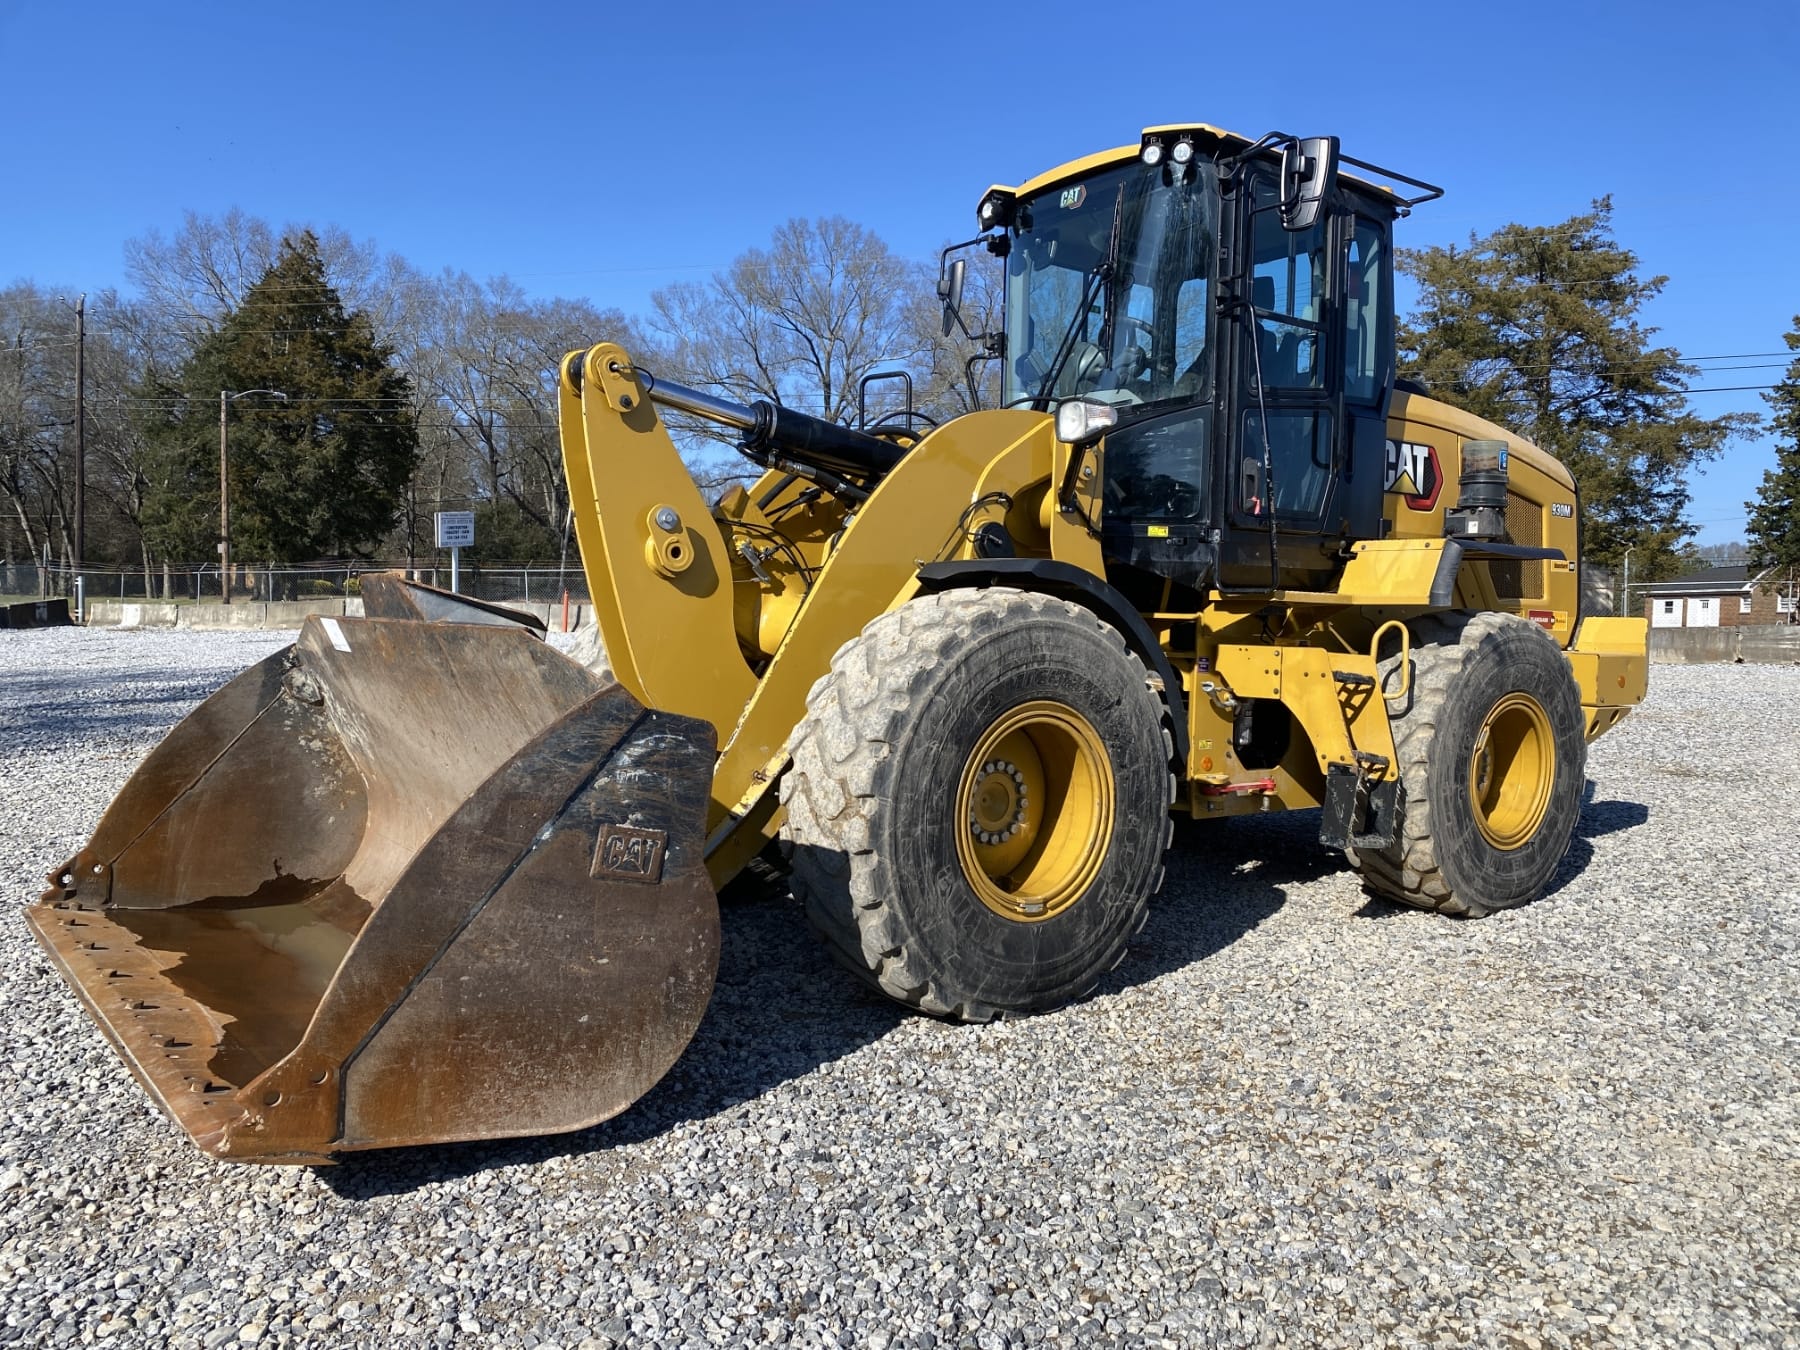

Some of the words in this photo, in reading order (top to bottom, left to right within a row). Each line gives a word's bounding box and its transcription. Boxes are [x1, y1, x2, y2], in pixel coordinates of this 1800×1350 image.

[1060, 186, 1081, 208] CAT
[1384, 440, 1429, 495] CAT
[1551, 503, 1571, 517] 930M
[603, 834, 661, 875] CAT
